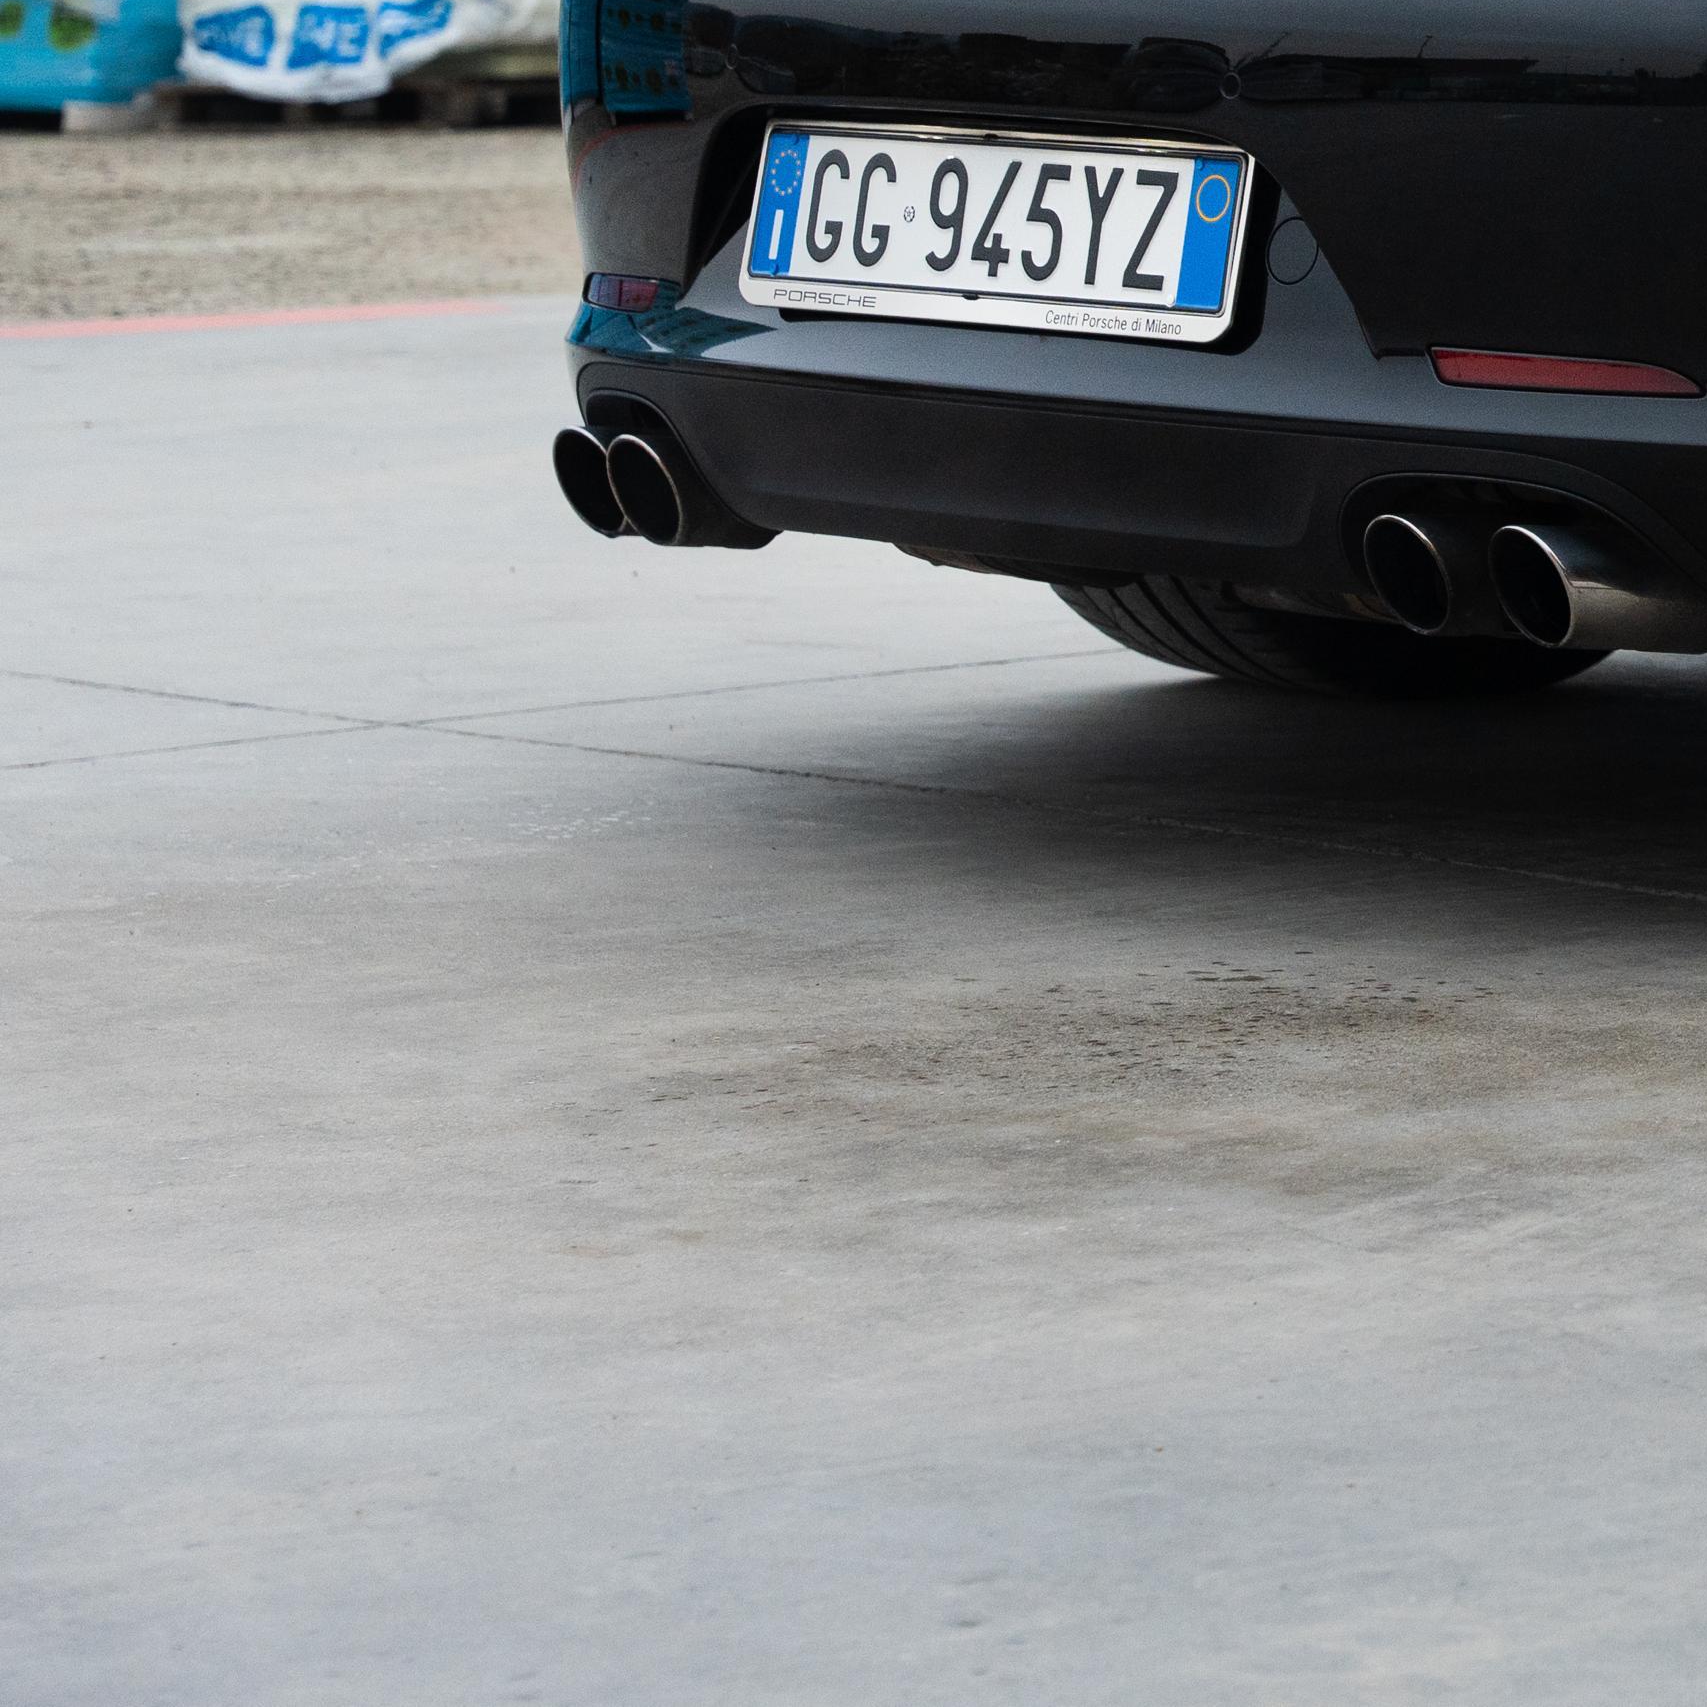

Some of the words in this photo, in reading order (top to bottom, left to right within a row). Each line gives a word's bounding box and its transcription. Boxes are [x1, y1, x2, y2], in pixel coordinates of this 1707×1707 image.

[768, 208, 784, 261] I
[805, 148, 897, 268] GG
[924, 157, 1179, 292] 945YZ
[772, 288, 877, 308] PORSCHE
[1045, 309, 1079, 327] Centri
[1082, 312, 1128, 332] Porsche
[1131, 315, 1143, 333] di
[1145, 316, 1182, 336] Milano
